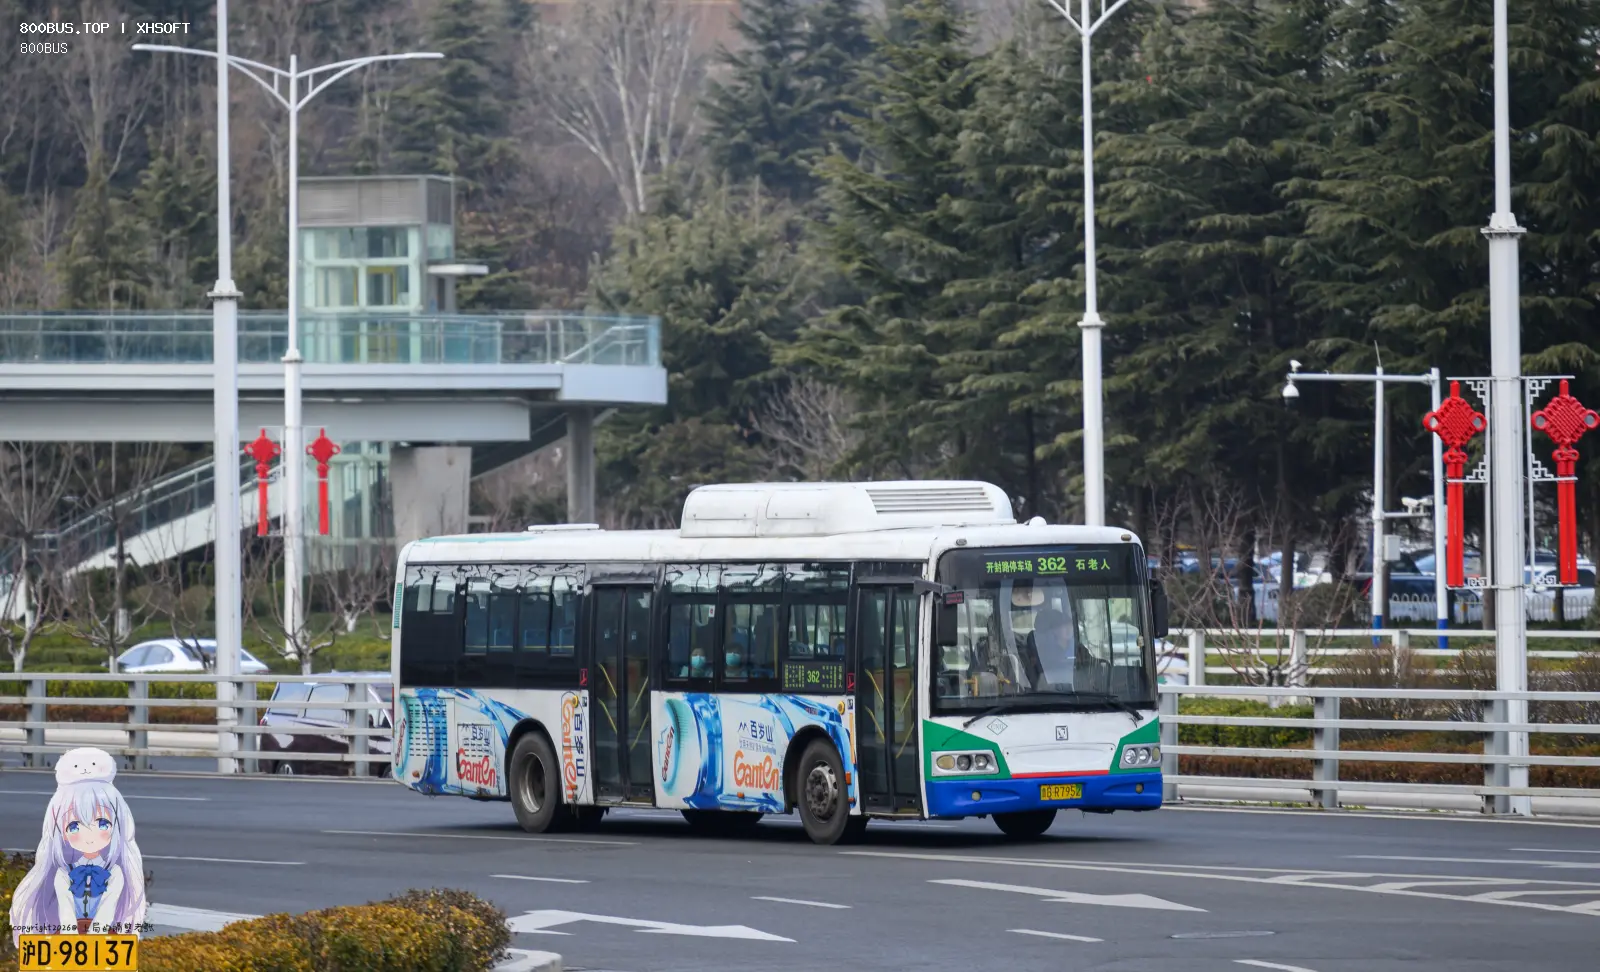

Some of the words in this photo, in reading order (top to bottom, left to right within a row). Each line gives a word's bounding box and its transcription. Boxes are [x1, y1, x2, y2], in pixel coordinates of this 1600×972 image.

[985, 560, 1033, 574] 开封路停车场
[1037, 557, 1067, 572] 362
[1075, 558, 1111, 571] 石老人
[807, 670, 820, 683] 362
[750, 720, 774, 743] 百岁山
